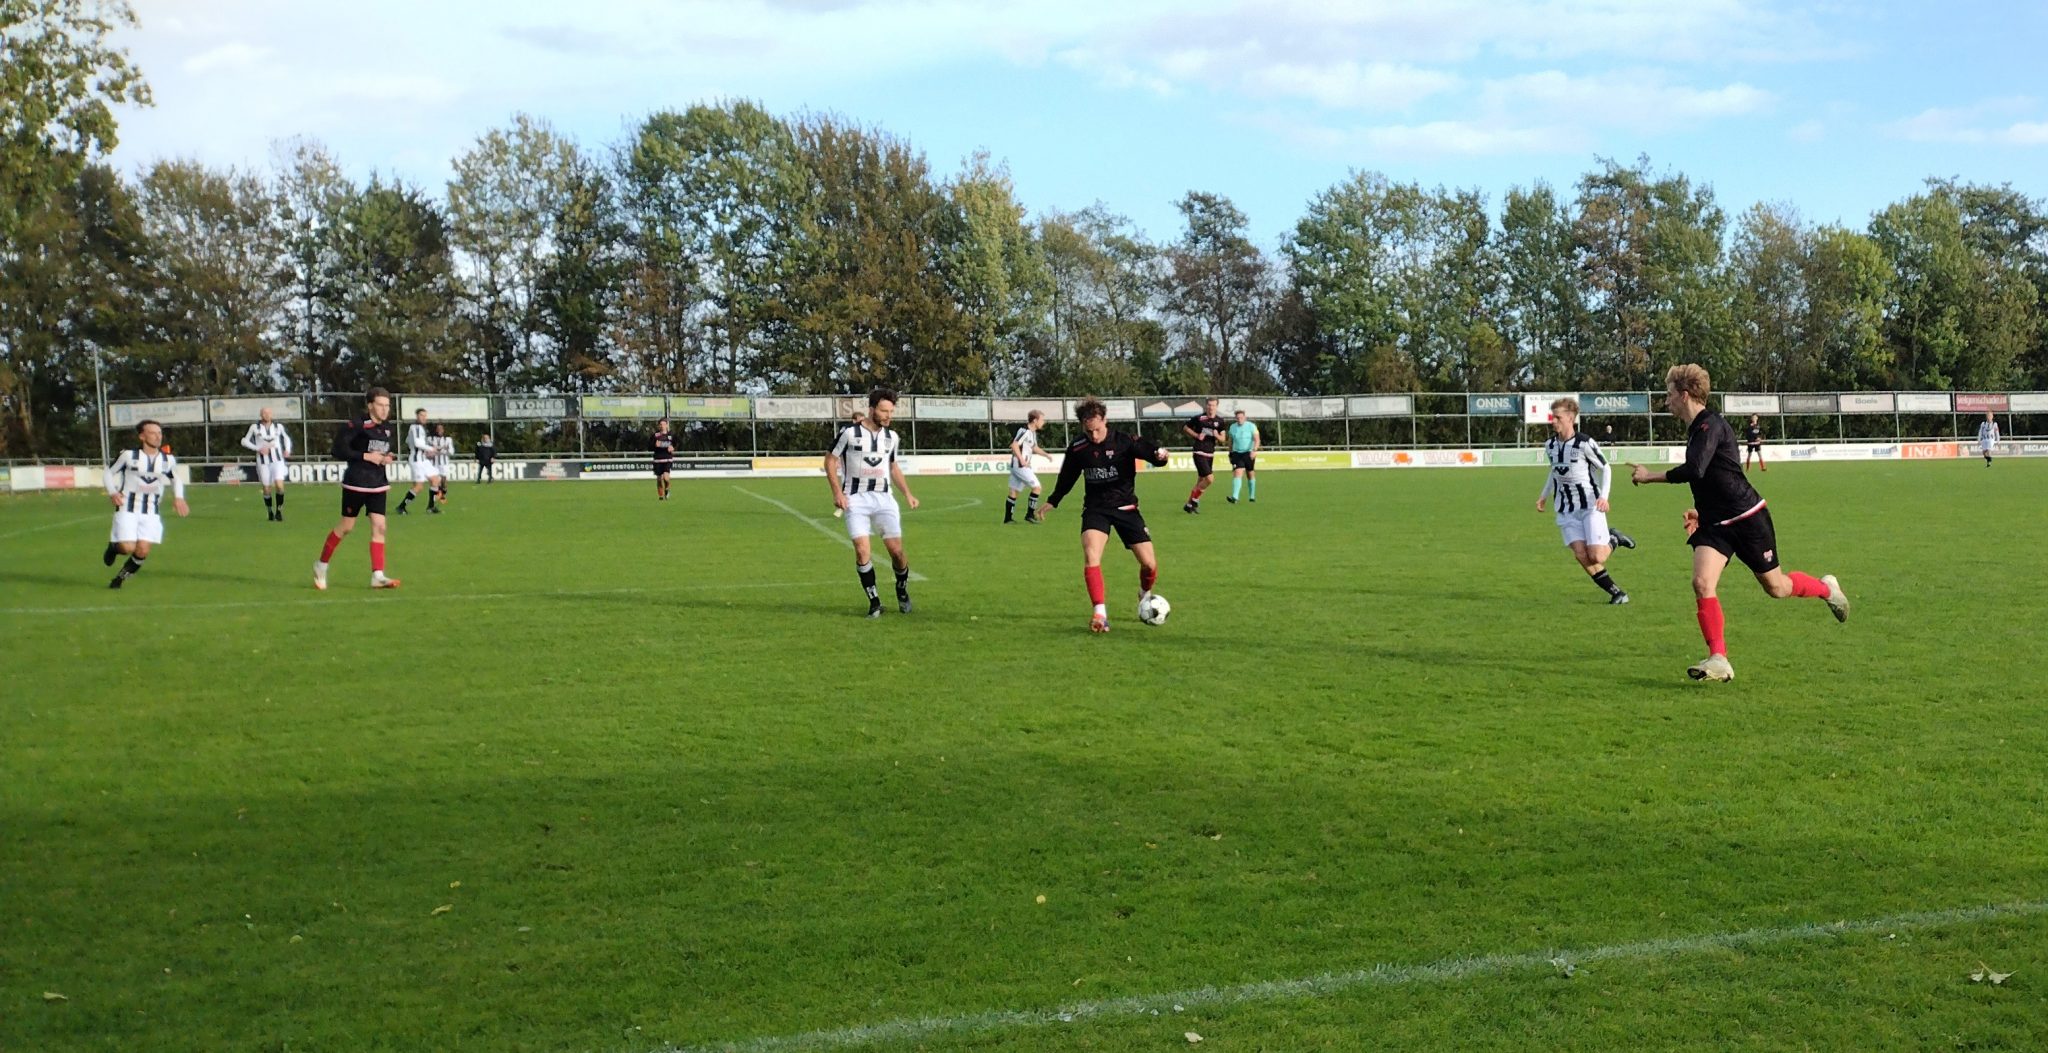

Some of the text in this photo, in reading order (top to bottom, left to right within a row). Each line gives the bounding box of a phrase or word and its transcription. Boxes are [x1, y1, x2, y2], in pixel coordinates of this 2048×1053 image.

[1476, 398, 1512, 408] ONNS.
[1594, 397, 1631, 407] ONNS.
[1908, 446, 1934, 457] ING
[955, 462, 990, 472] DEPA
[1168, 458, 1196, 469] LUS
